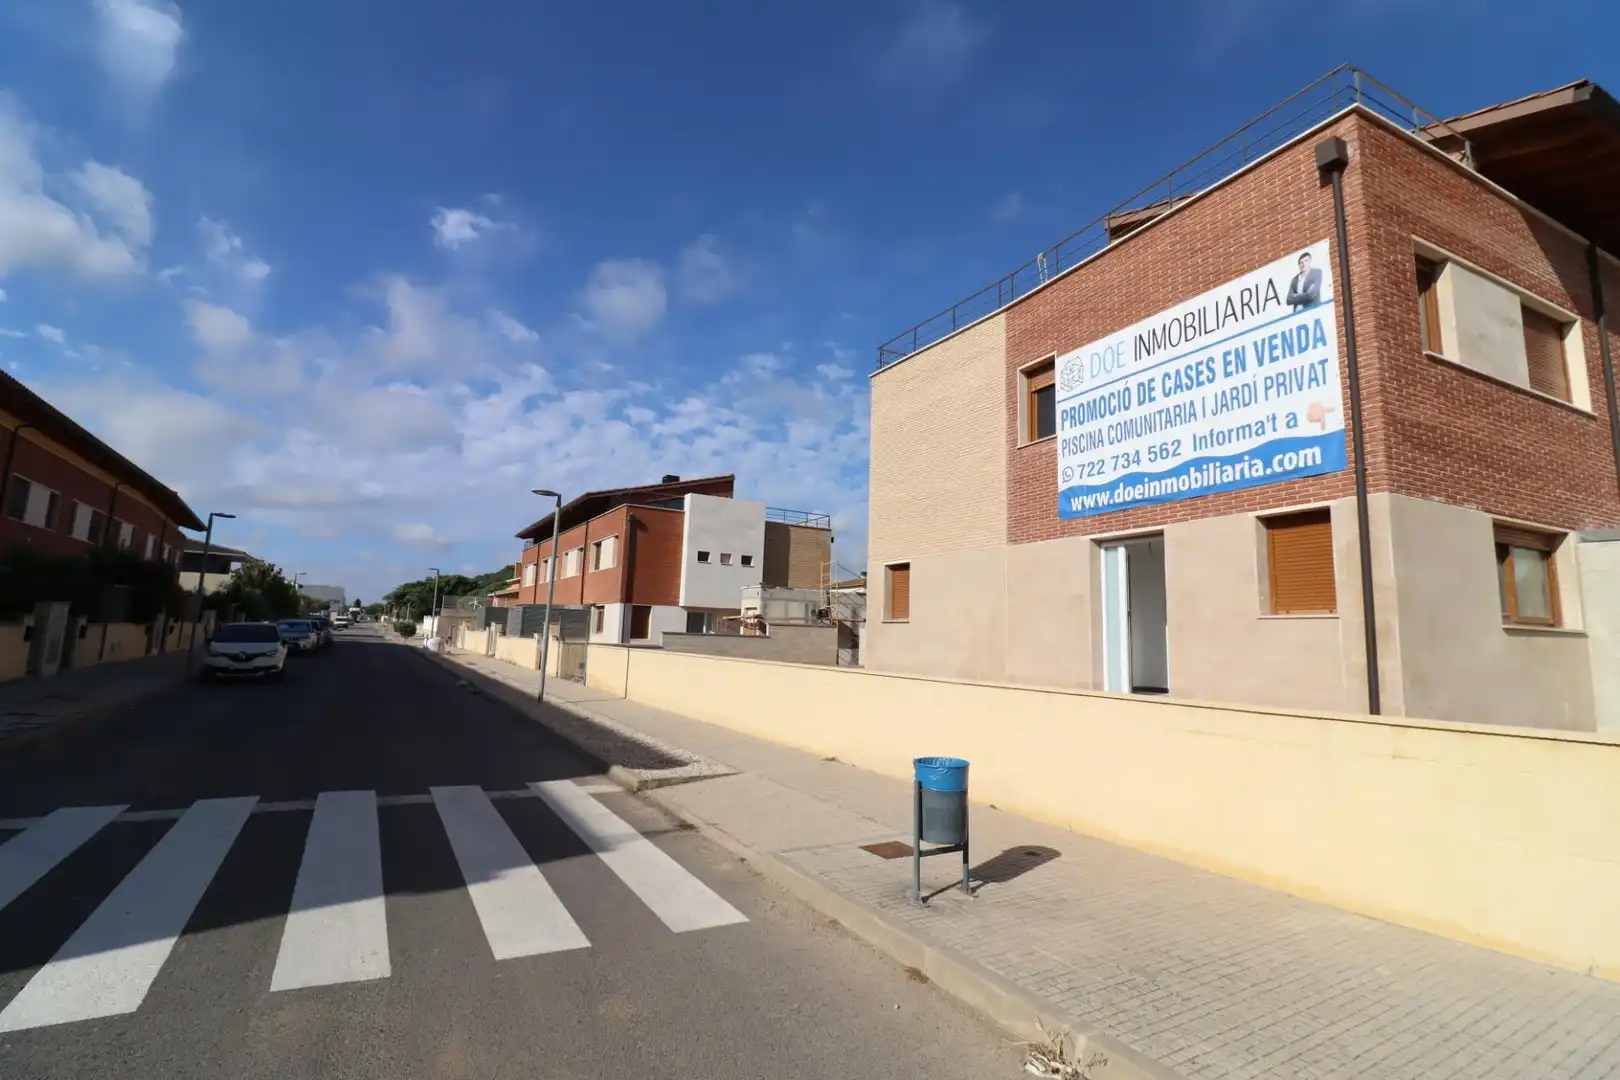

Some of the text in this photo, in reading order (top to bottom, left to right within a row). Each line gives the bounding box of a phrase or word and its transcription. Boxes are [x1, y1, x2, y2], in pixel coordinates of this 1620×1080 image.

[1061, 318, 1327, 431] PROMOCIÓ DE CASES EN VENDA
[1090, 278, 1280, 378] DOE INMOBILIARIA
[1062, 358, 1328, 458] PISCINA COMUNITARIA I JARDÍ PRIVAT
[1077, 412, 1298, 479] 722 734 562 Informa't a
[1070, 446, 1322, 511] www.doeinmobiliaria.com
